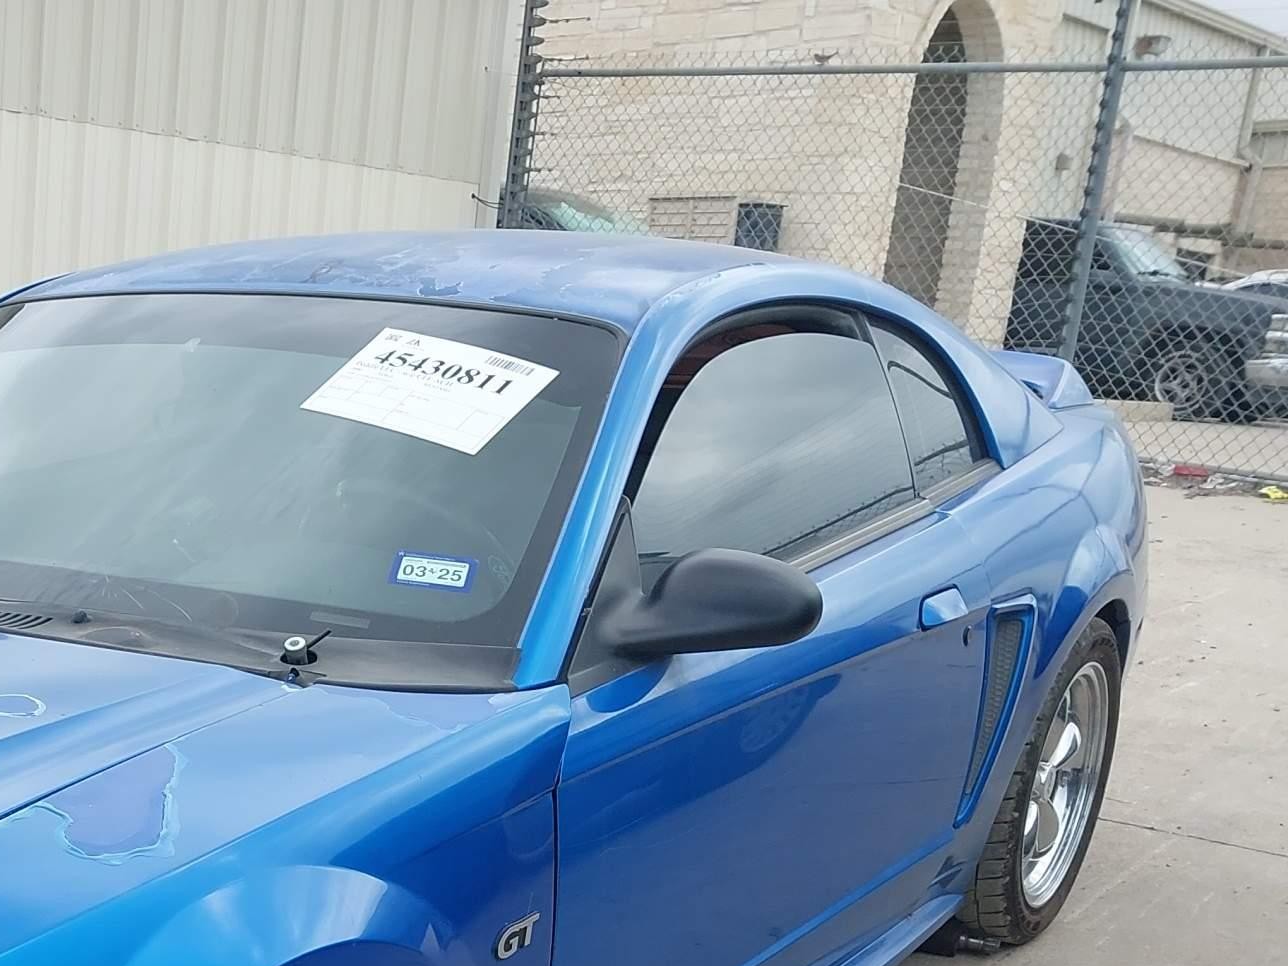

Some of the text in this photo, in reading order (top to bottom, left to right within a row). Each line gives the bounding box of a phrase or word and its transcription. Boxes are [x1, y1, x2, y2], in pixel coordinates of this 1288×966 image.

[374, 349, 515, 395] 45430811
[402, 564, 464, 582] 03 25
[497, 912, 541, 960] GT
